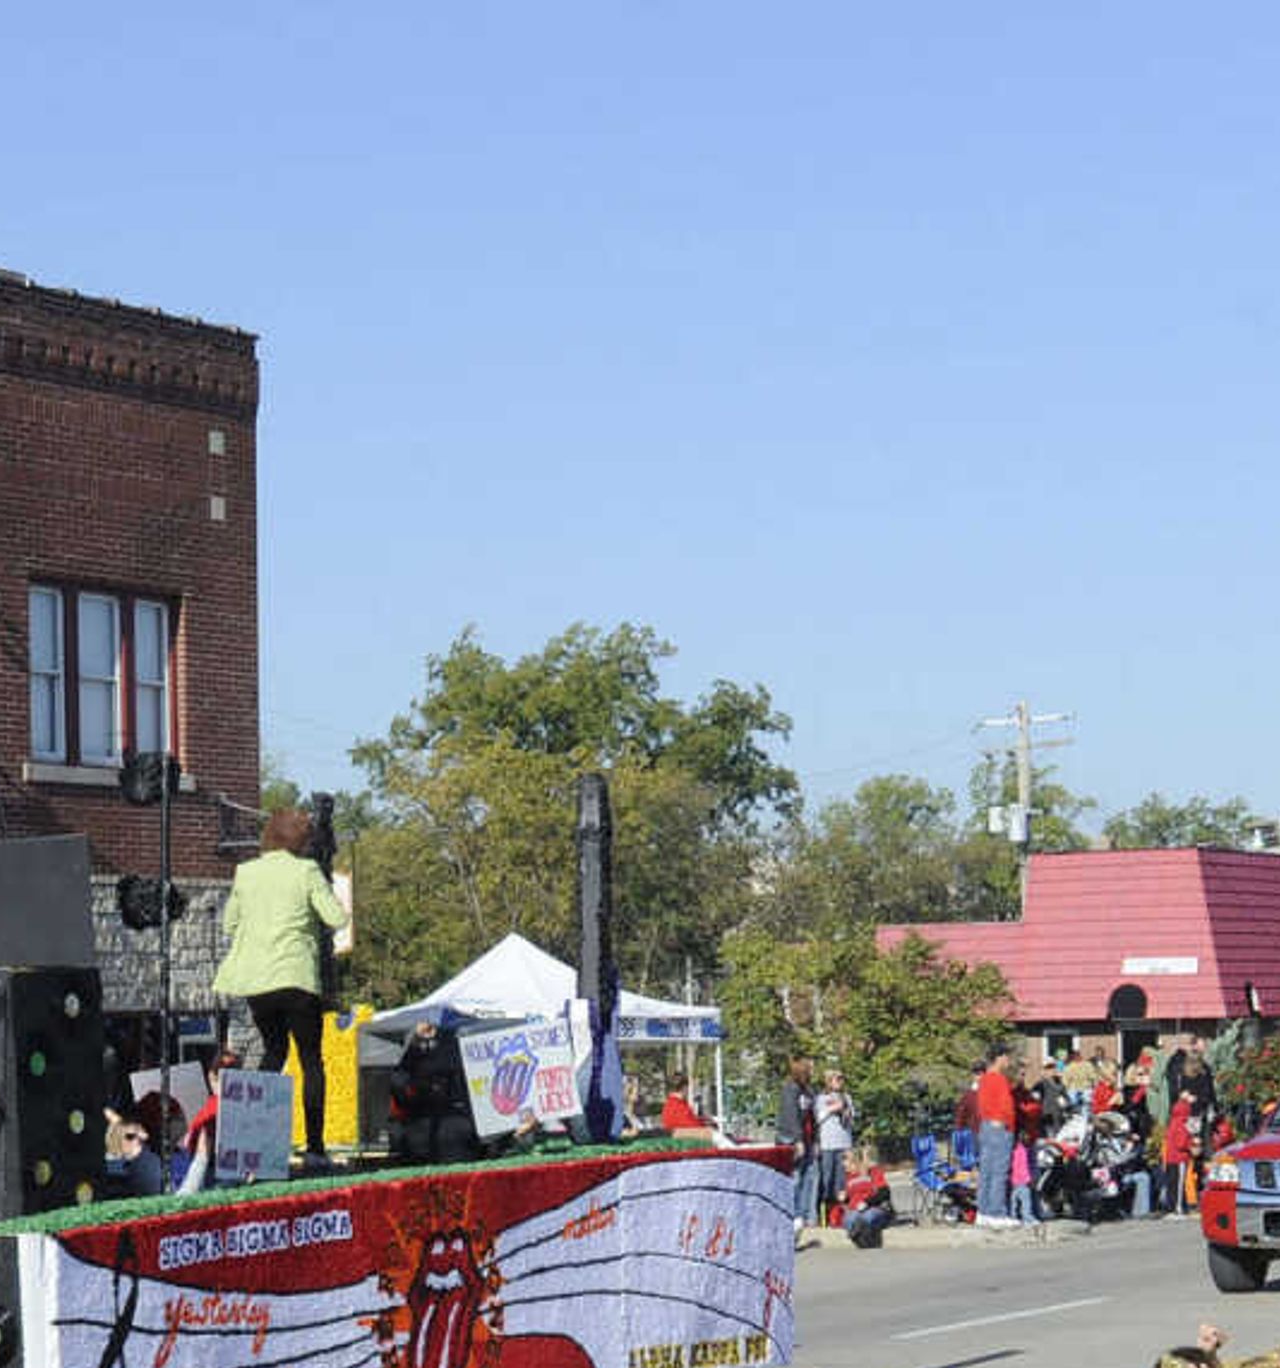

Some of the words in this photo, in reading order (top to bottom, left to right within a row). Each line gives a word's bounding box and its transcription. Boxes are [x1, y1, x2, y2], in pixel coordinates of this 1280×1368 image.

[161, 1231, 221, 1268] SIGMA
[226, 1220, 289, 1255] SIGMA
[293, 1211, 351, 1245] SIGMA
